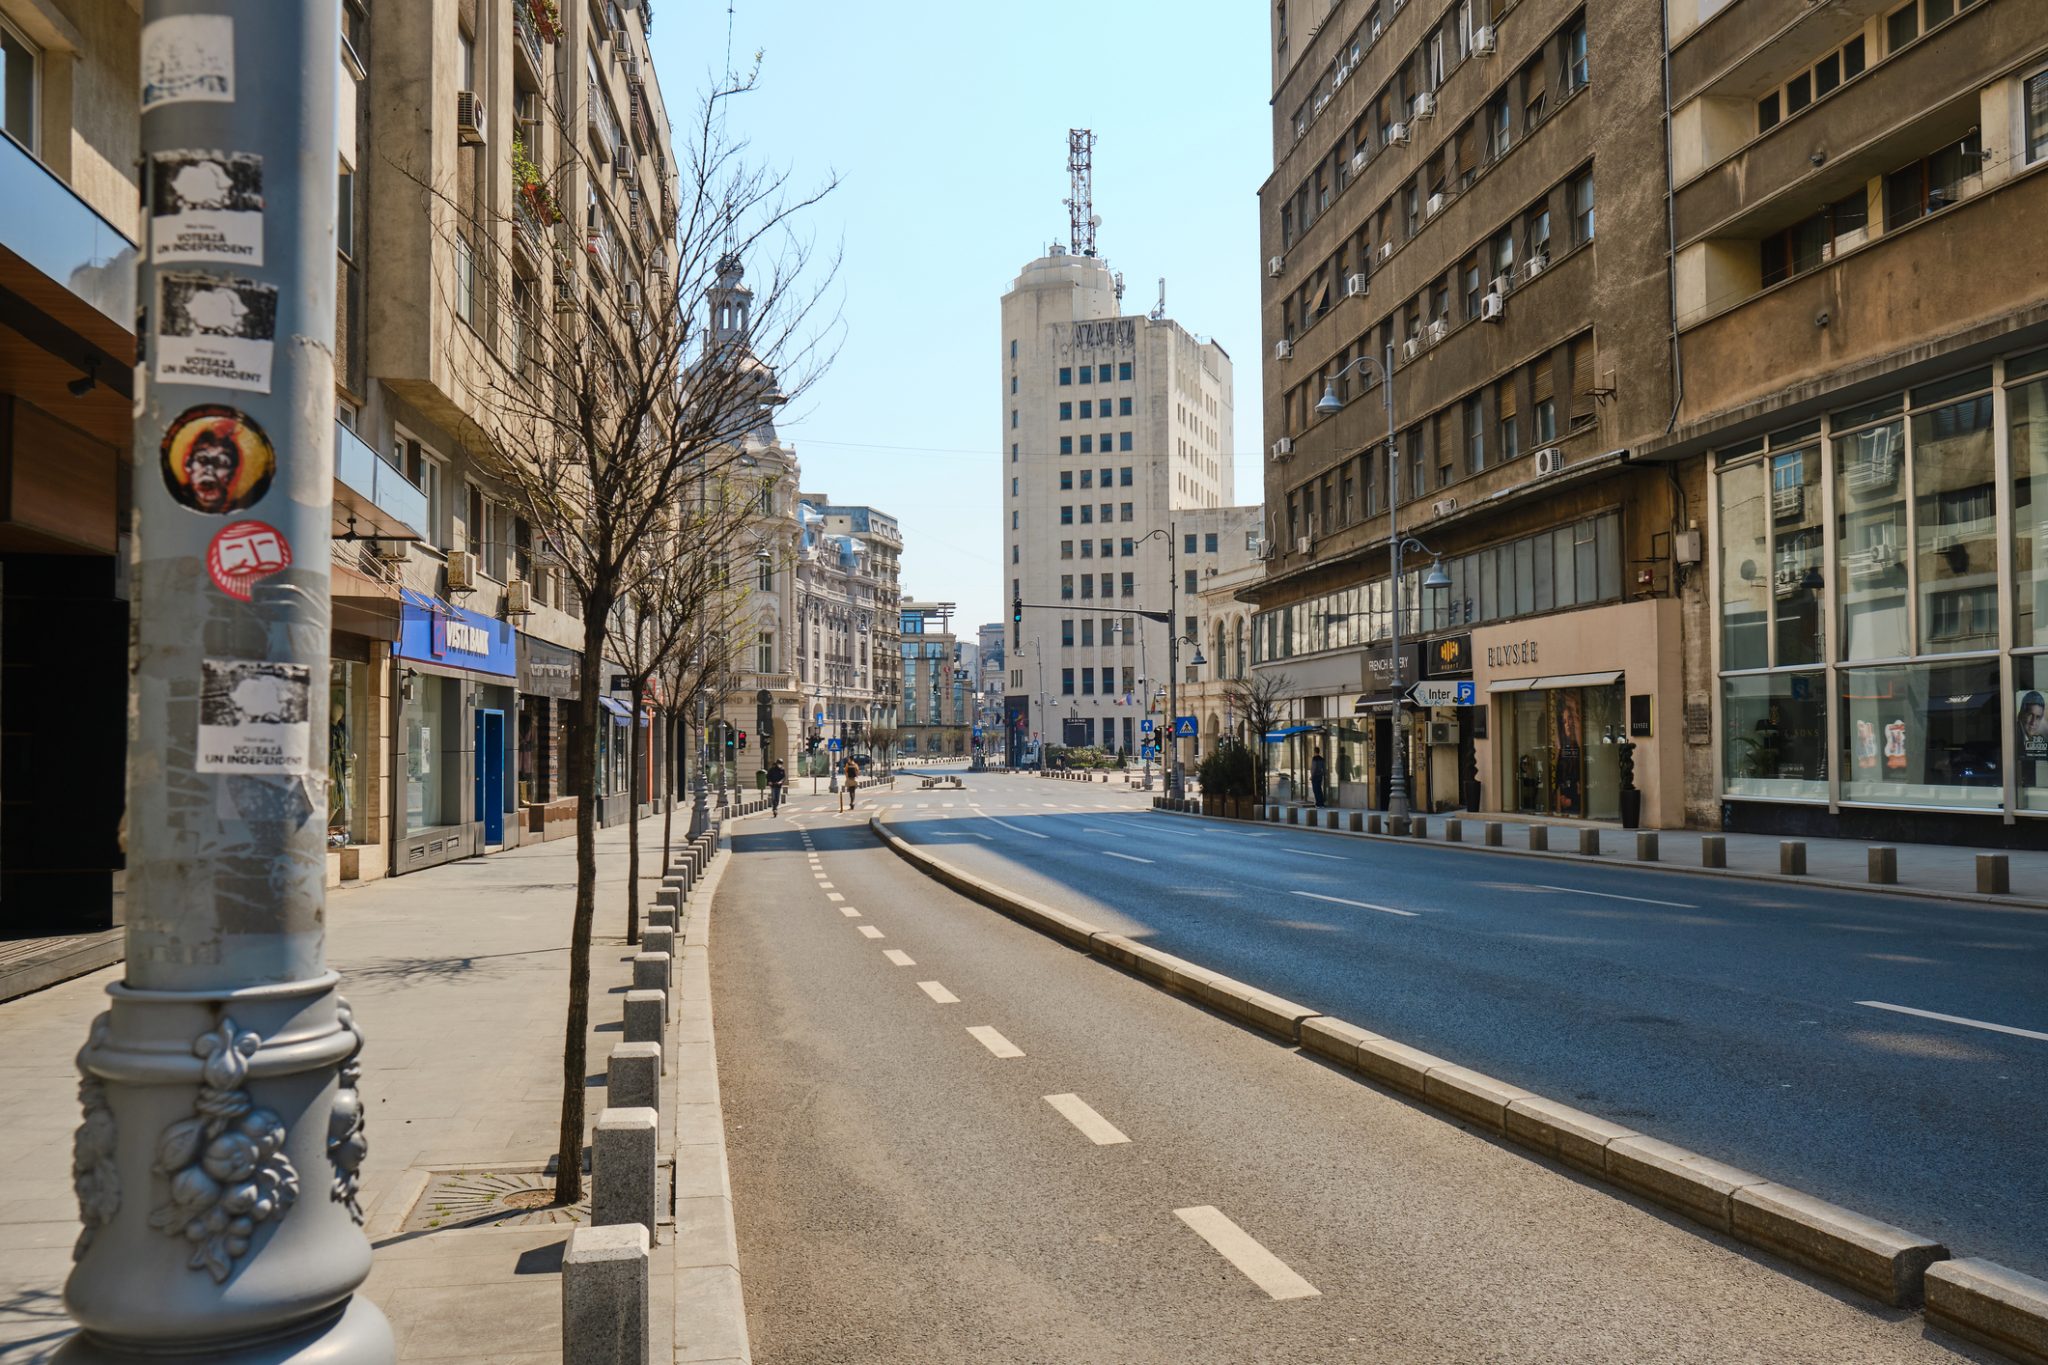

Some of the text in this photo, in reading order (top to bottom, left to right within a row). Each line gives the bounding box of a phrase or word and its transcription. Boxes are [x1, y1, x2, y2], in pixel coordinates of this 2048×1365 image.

[173, 242, 254, 256] INDEPENDENT
[179, 364, 262, 383] INDEPENDENT
[446, 620, 490, 656] VISTA BANK
[1488, 639, 1538, 668] ELYSÉE
[1368, 658, 1389, 672] FRENCH
[1429, 688, 1451, 700] Inter
[205, 754, 303, 766] UN INDEPENDENT
